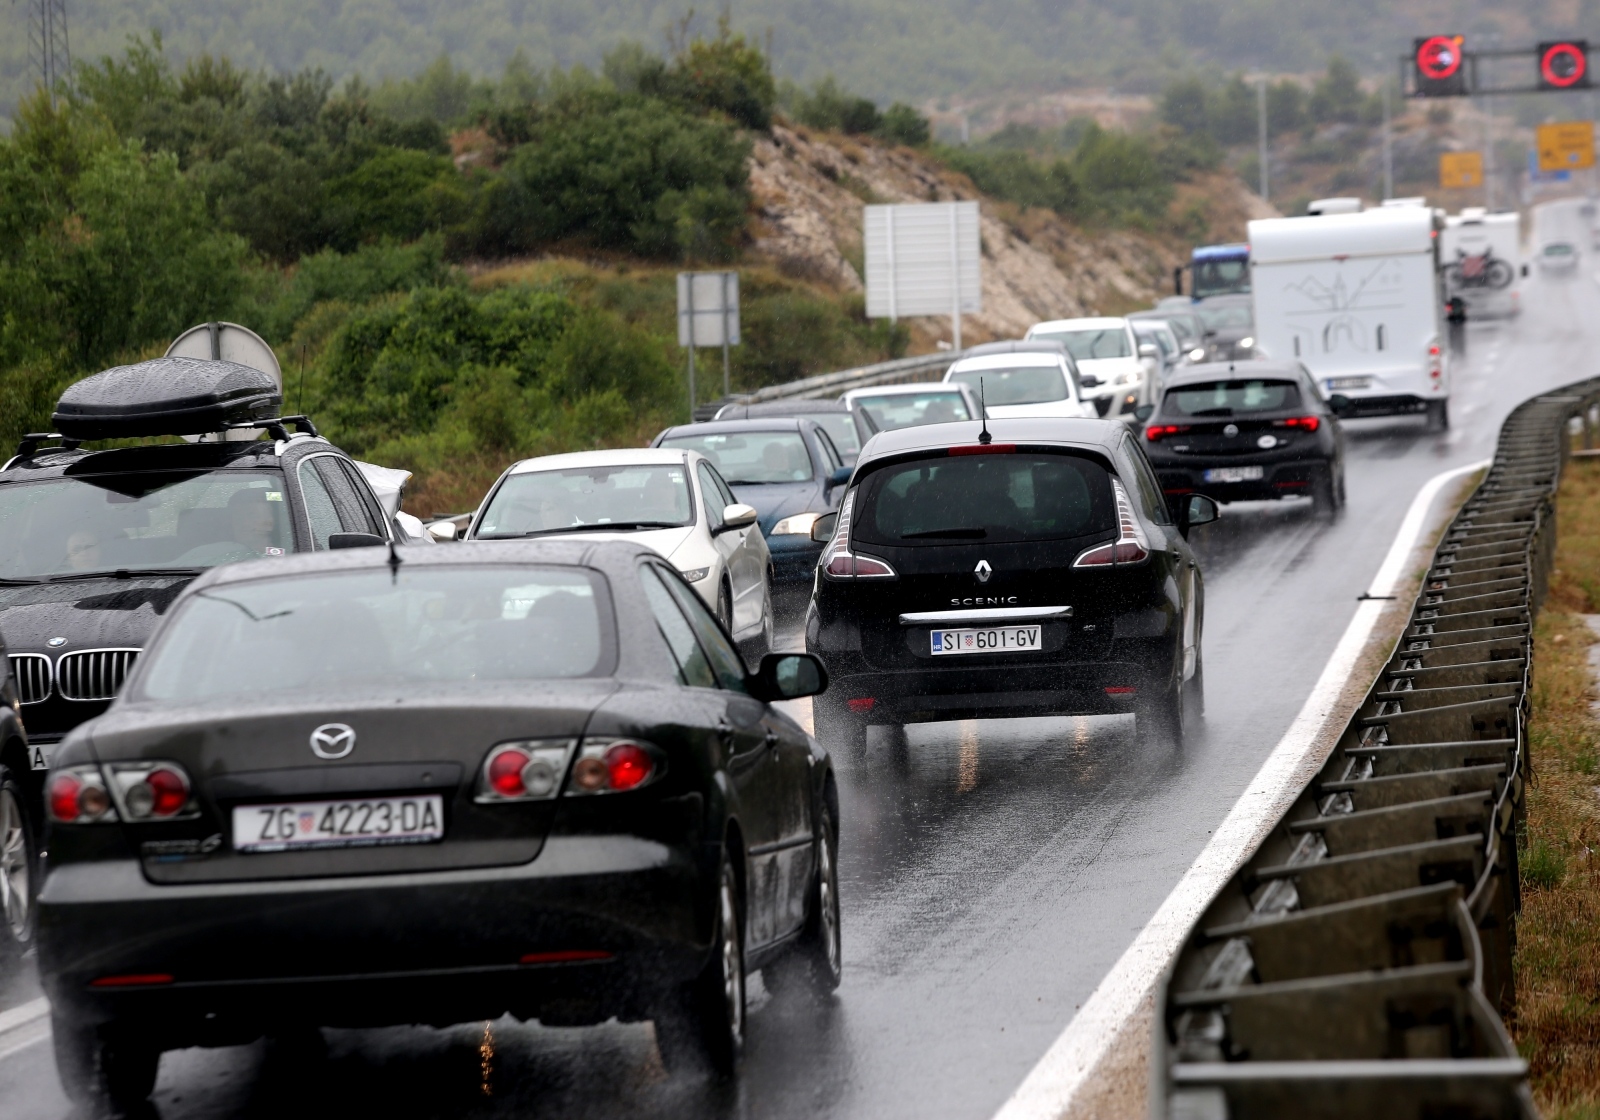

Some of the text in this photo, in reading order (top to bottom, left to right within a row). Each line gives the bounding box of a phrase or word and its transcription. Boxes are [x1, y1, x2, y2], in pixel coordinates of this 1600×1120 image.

[950, 596, 1018, 606] SCENIC
[976, 629, 1037, 648] 601-GV
[258, 800, 438, 841] ZG 4223-DA
